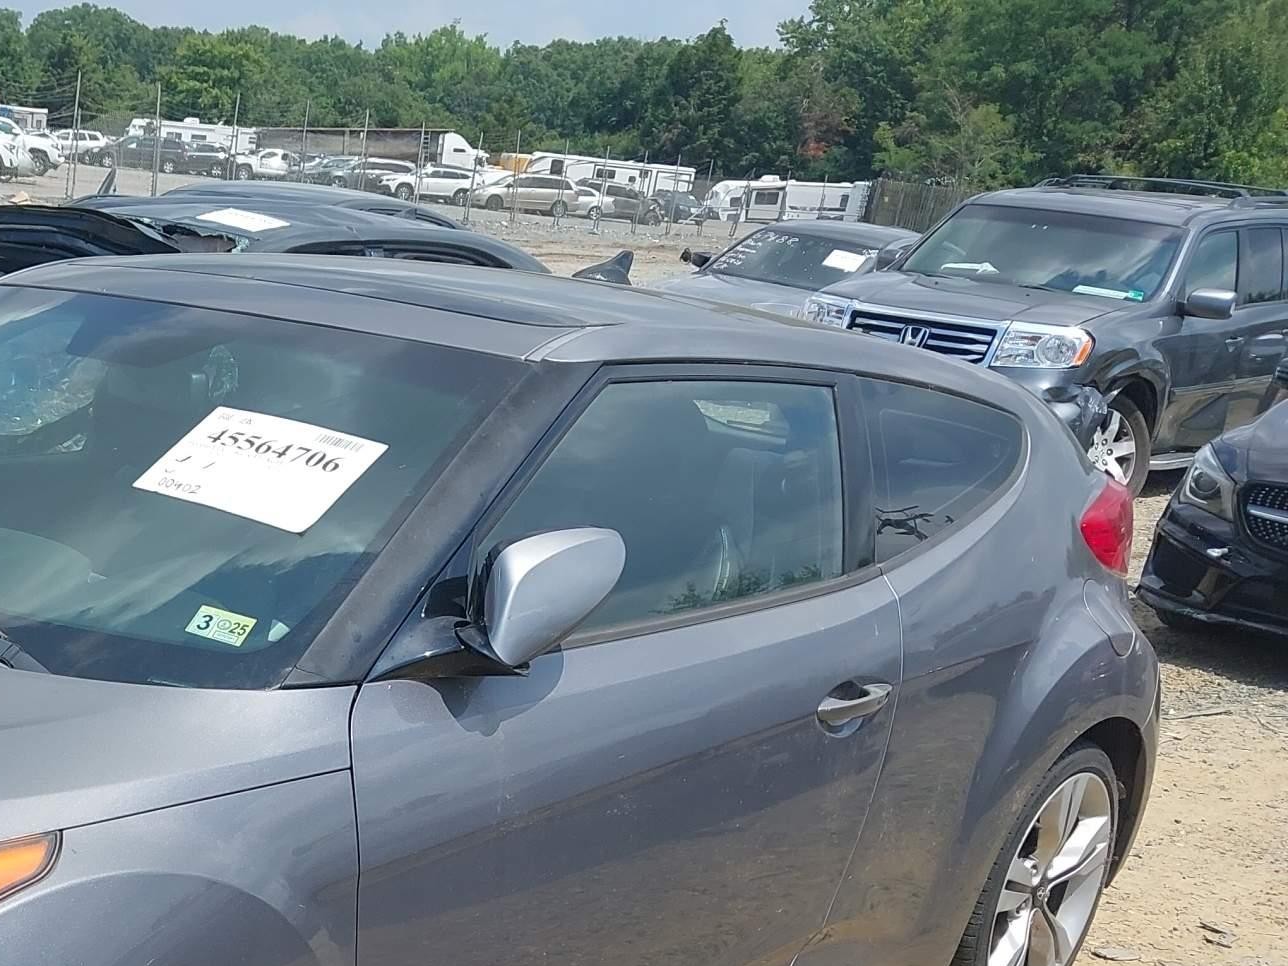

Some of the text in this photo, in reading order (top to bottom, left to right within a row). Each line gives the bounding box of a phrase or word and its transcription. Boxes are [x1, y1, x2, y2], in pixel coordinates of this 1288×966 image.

[206, 427, 344, 473] 45564706
[196, 614, 214, 631] 3
[228, 622, 250, 637] 25
